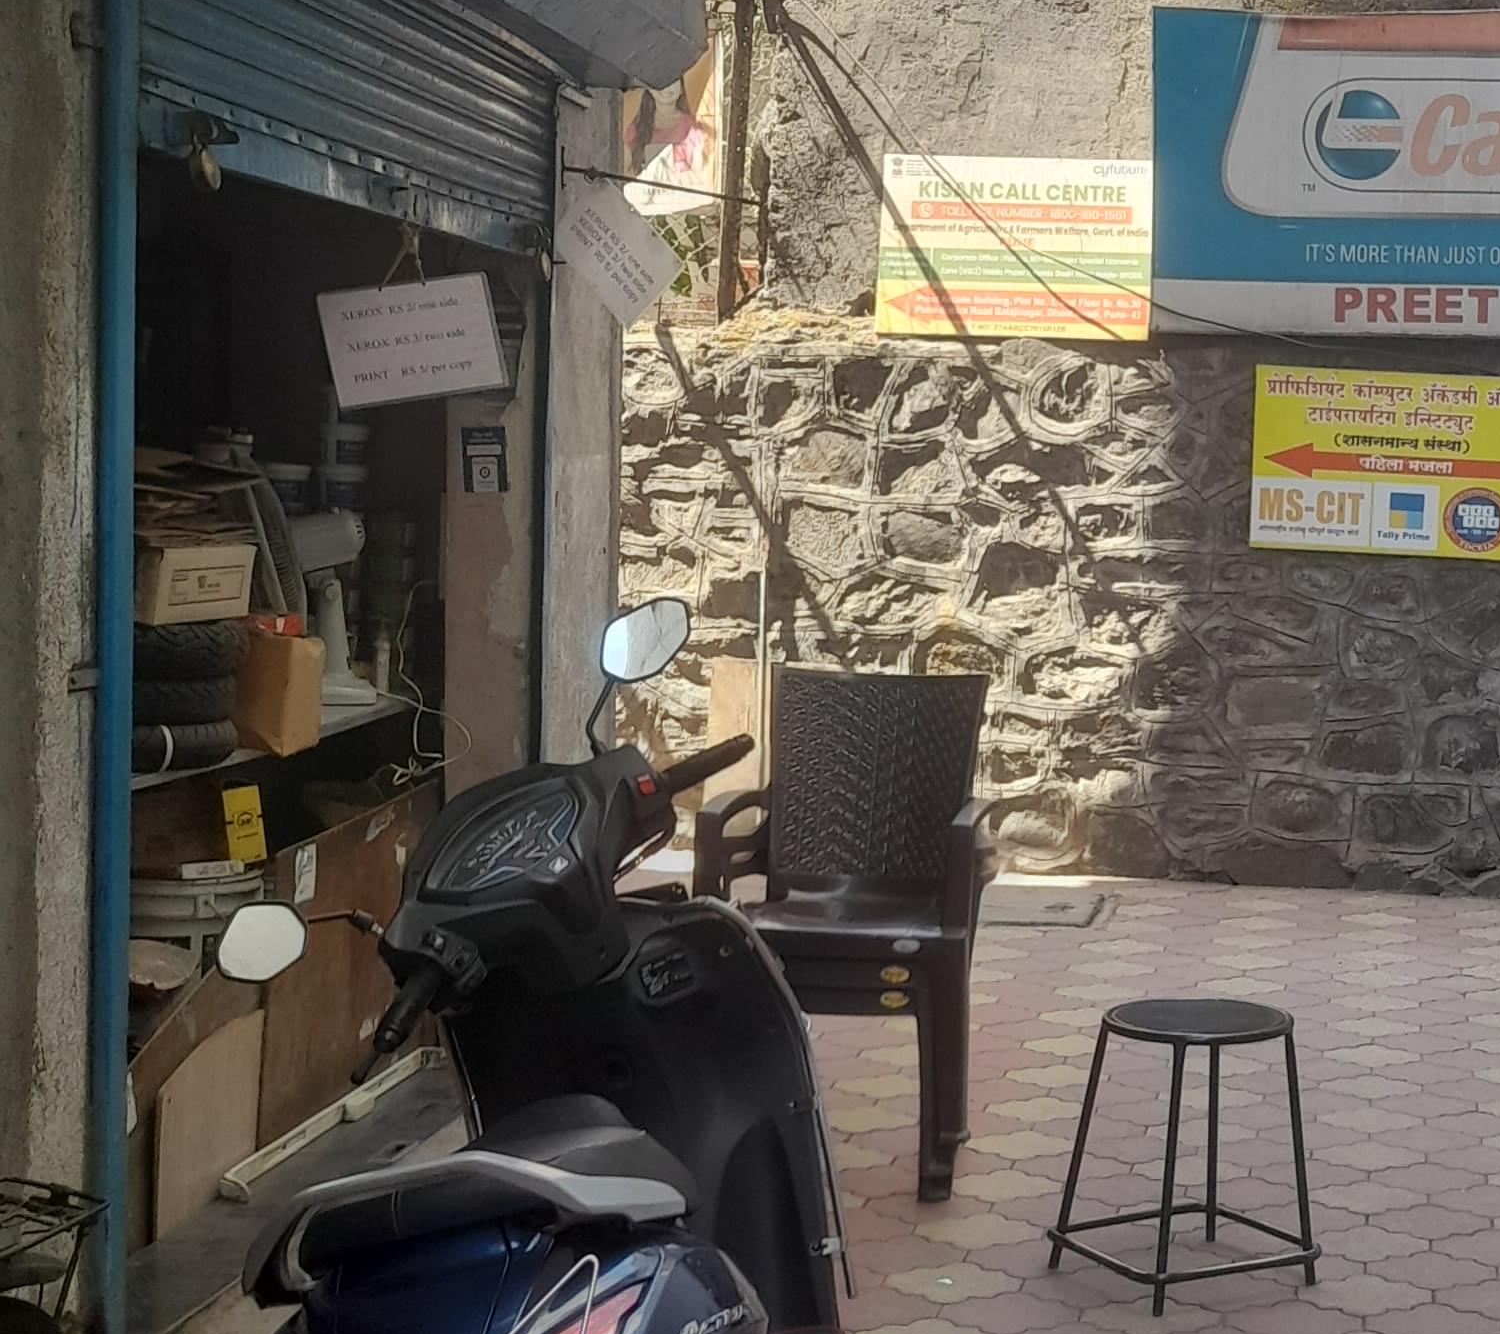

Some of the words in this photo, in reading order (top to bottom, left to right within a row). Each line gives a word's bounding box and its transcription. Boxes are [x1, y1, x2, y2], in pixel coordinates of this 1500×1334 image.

[989, 182, 1042, 201] CALL
[1045, 184, 1127, 203] CENTRE
[1305, 243, 1335, 263] IT'S
[1340, 244, 1389, 264] MORE
[1394, 245, 1439, 265] THAN
[1443, 246, 1486, 266] JUST
[1334, 287, 1499, 324] PREET
[1359, 456, 1403, 472] पहिला
[1408, 458, 1453, 474] मजला
[1259, 487, 1365, 525] MS-CIT
[1403, 532, 1430, 541] Prime
